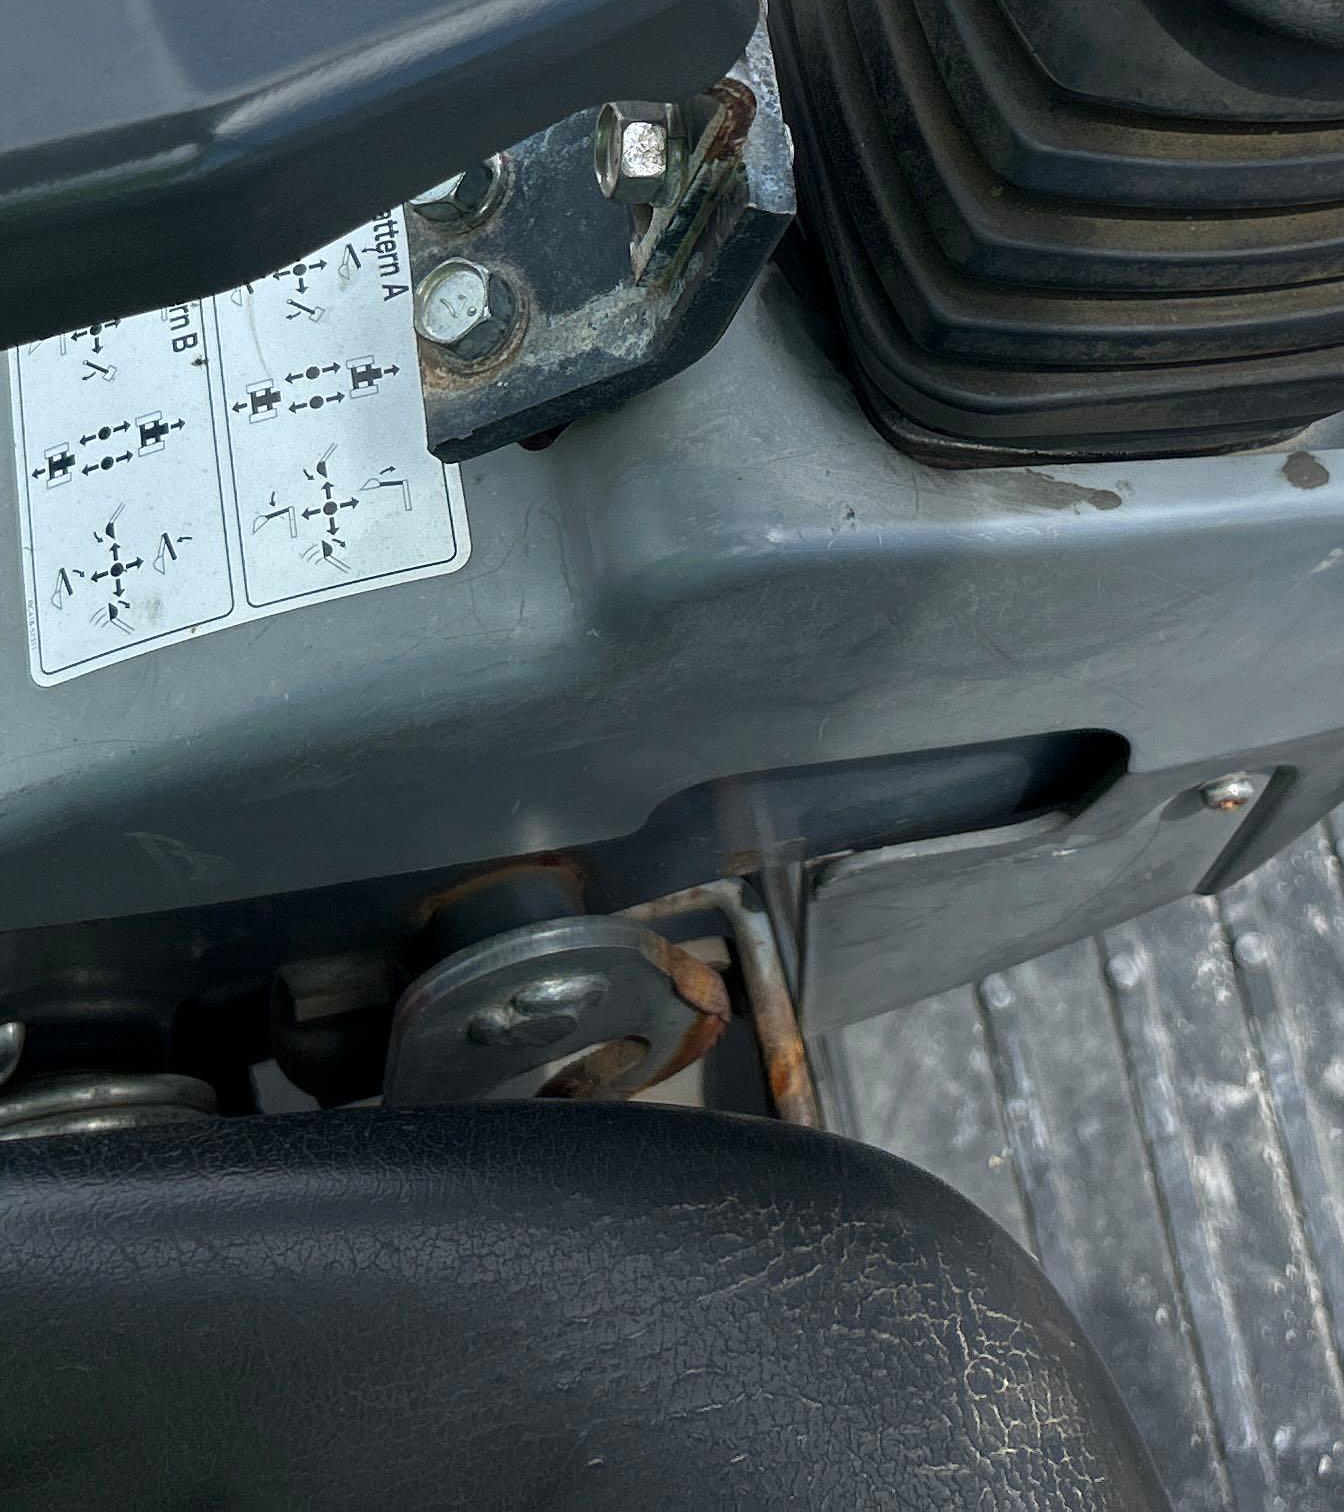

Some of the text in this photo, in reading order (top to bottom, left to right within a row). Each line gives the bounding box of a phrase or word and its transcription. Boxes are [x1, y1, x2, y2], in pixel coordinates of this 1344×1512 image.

[372, 209, 410, 302] attern A
[171, 332, 198, 354] B
